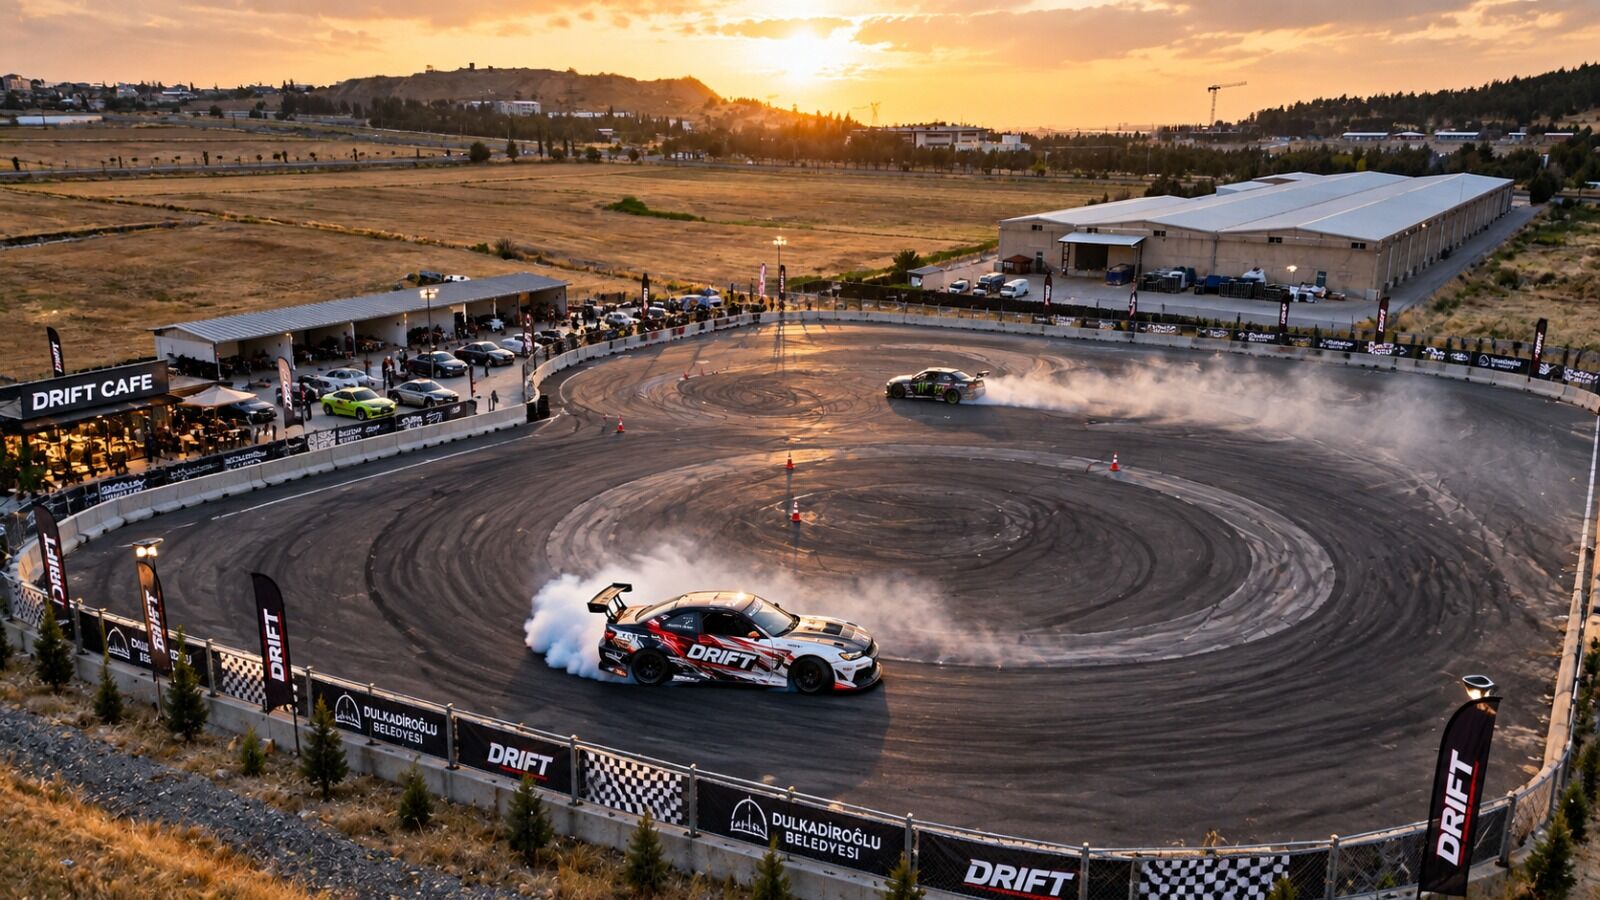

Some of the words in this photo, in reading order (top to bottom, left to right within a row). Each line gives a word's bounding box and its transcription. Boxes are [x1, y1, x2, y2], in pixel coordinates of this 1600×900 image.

[32, 383, 96, 410] DRIFT
[101, 374, 152, 397] CAFE
[43, 532, 65, 606] DRIFT
[263, 608, 284, 682] DRIFT
[686, 644, 756, 669] DRIFT
[487, 742, 553, 776] DRIFT
[1437, 749, 1472, 866] DRIFT
[964, 859, 1074, 896] DRIFT
